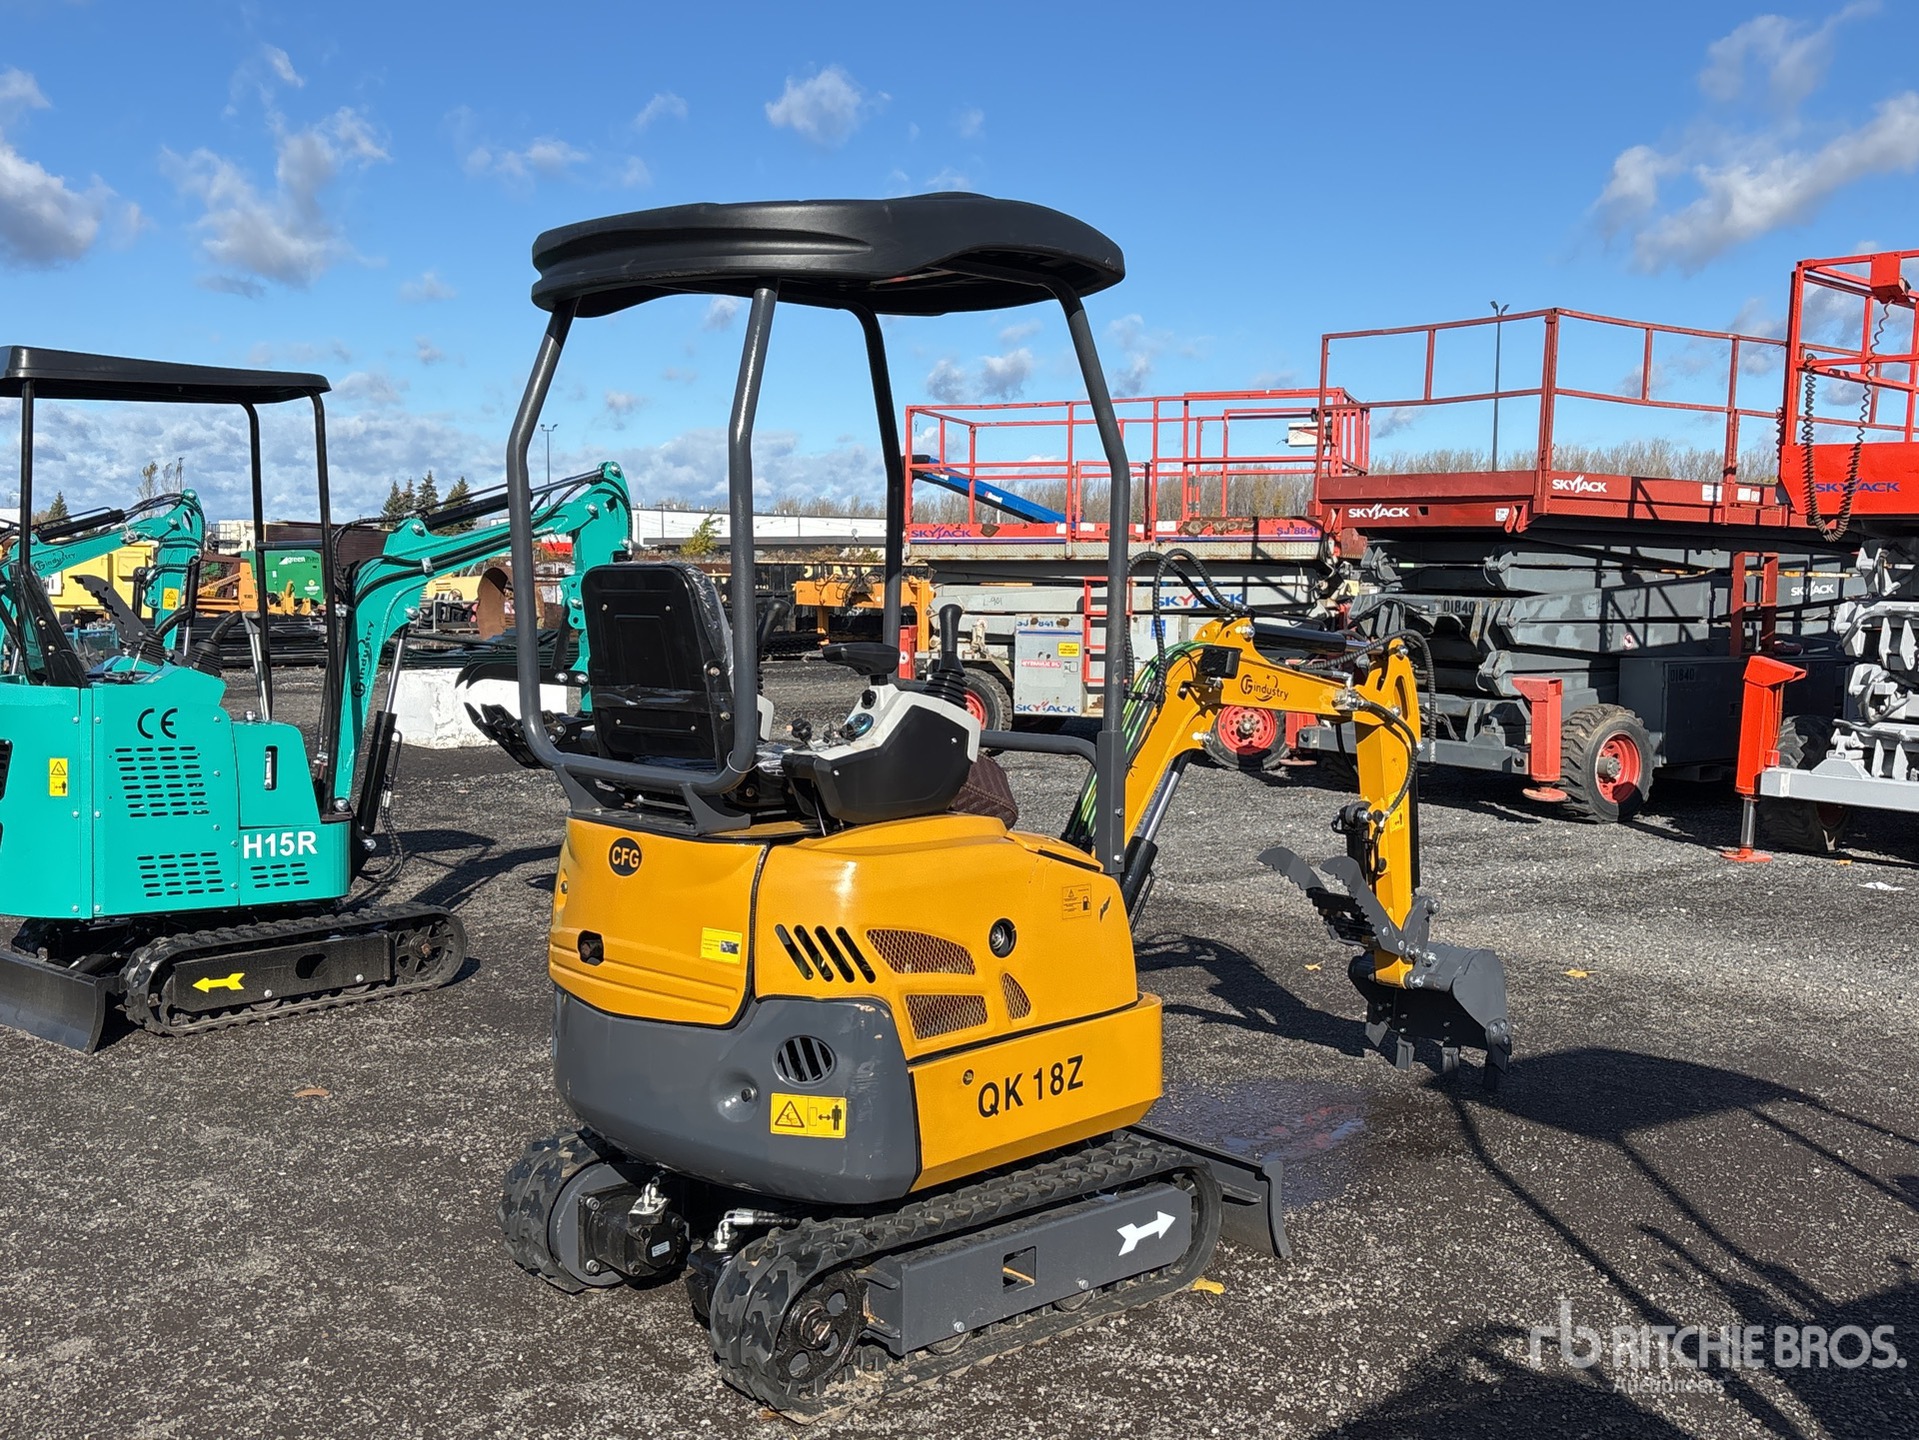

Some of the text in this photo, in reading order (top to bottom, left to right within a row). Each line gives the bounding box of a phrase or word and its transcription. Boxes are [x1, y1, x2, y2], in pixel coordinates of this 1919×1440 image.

[1552, 475, 1607, 494] SKYJACK
[1348, 503, 1411, 520] SKYJACK
[911, 526, 972, 540] SKYJACK
[1158, 589, 1243, 608] SKYJAK
[1253, 680, 1289, 702] industry
[1015, 699, 1078, 714] SKYACK
[137, 707, 178, 739] CE
[243, 831, 318, 860] H15R
[611, 846, 640, 869] CFG
[978, 1054, 1084, 1118] QK 18Z
